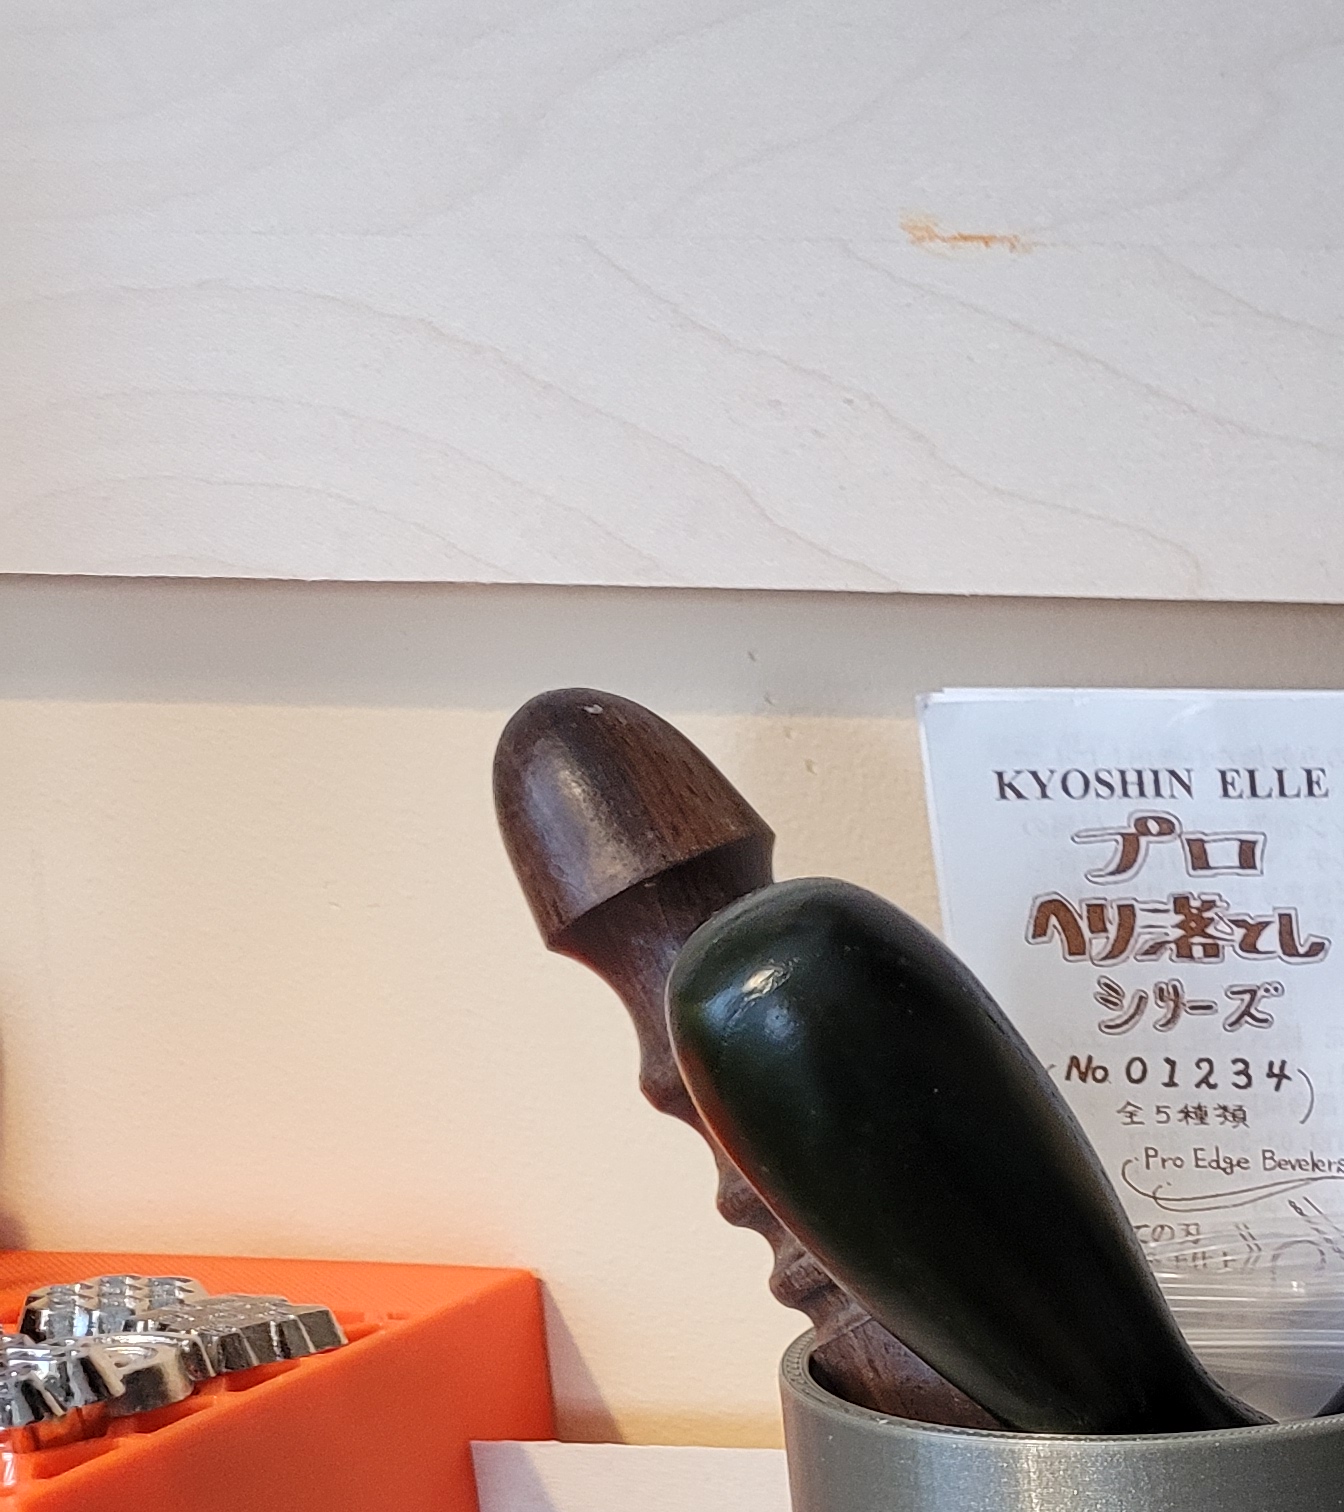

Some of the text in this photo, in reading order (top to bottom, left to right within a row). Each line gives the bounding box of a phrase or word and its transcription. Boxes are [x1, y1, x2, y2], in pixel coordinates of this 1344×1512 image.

[993, 767, 1331, 801] KYOSHIN ELLE
[1071, 809, 1267, 886] プロ
[1094, 975, 1285, 1035] シリーズ
[1143, 1145, 1186, 1172] Pro
[1192, 1144, 1251, 1177] Edge
